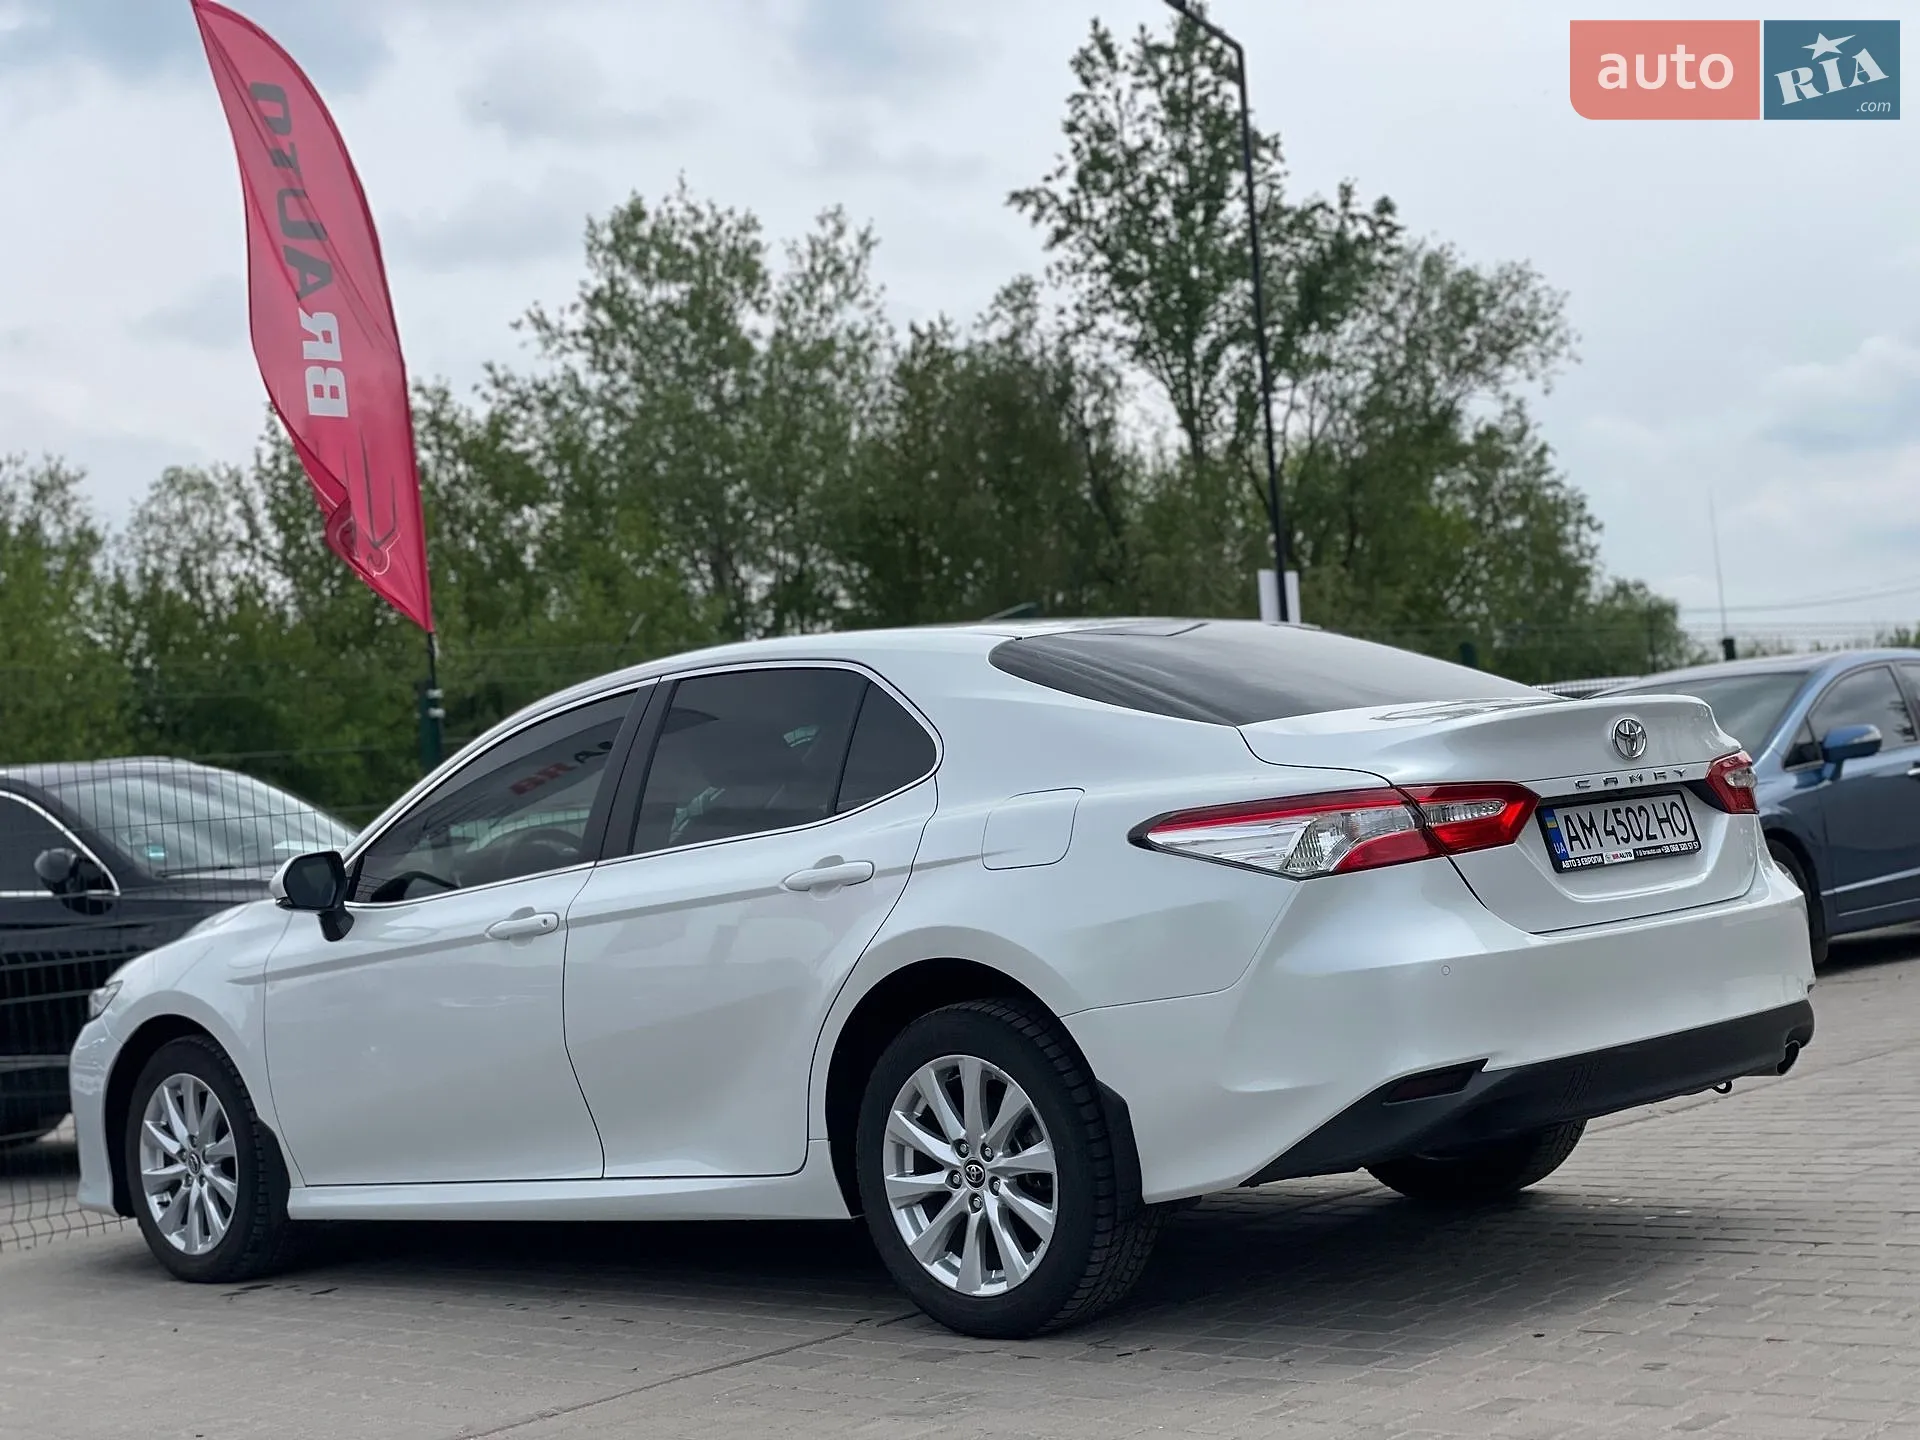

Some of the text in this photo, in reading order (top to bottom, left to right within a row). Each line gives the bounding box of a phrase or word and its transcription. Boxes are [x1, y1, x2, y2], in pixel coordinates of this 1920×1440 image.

[1574, 767, 1687, 789] CAMRY
[1563, 800, 1688, 852] AM 4502 HO
[1553, 843, 1567, 854] UA
